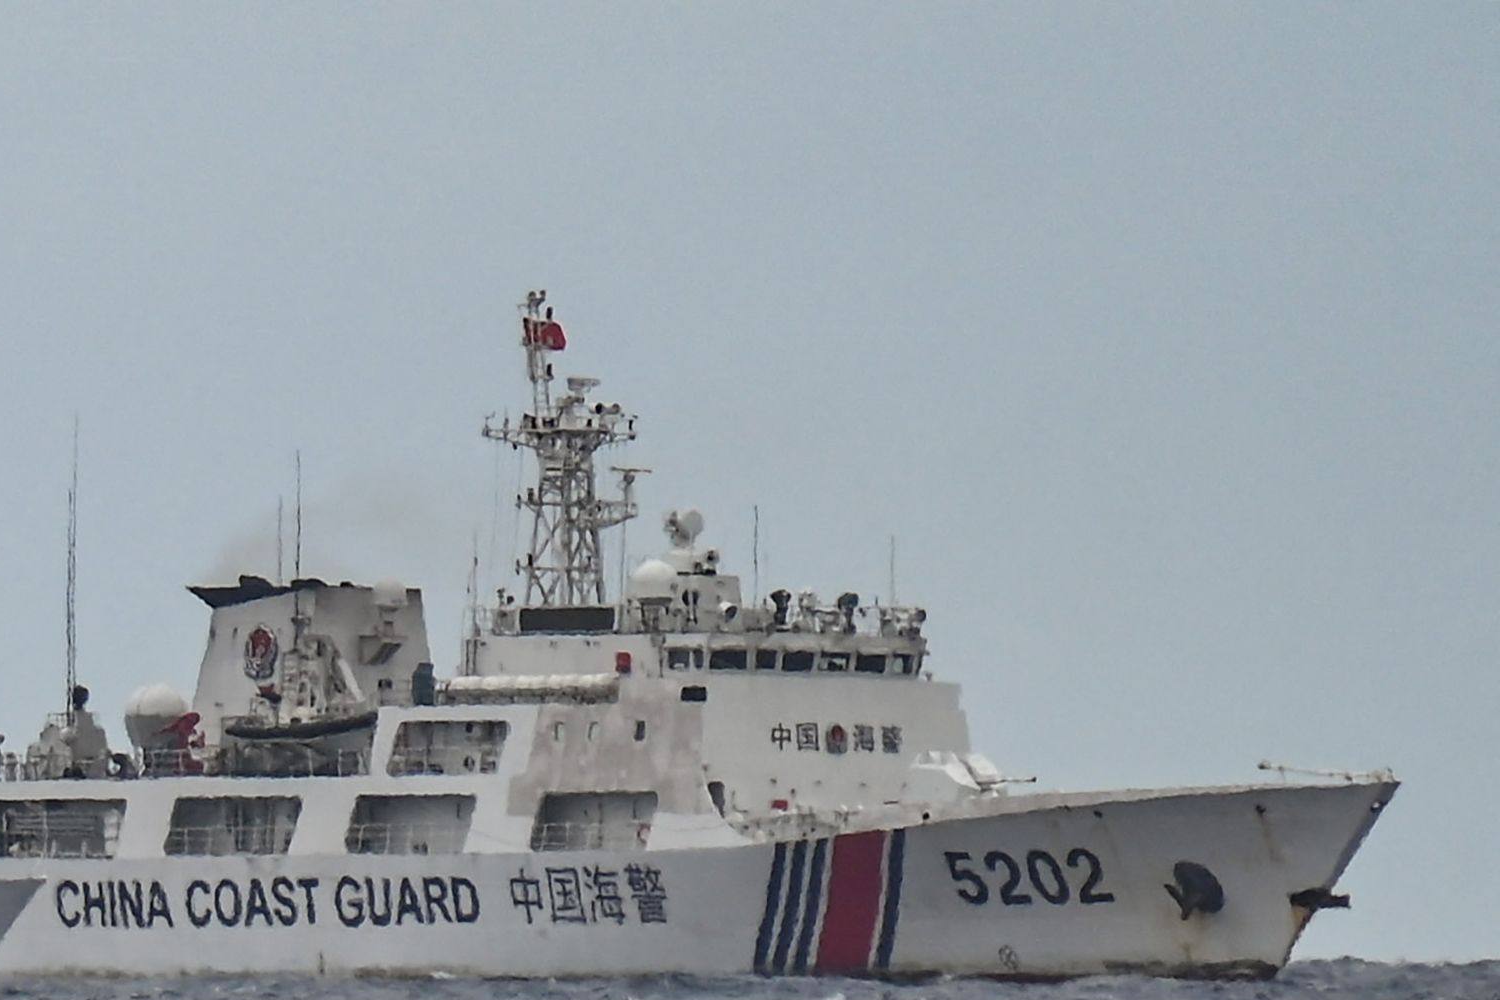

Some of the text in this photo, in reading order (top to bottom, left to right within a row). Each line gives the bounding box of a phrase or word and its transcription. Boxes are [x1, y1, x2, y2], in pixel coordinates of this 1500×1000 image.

[770, 722, 820, 752] 中国
[55, 874, 481, 930] CHINA COAST GUARD
[509, 863, 668, 926] 中国海警
[943, 847, 1115, 906] 5202
